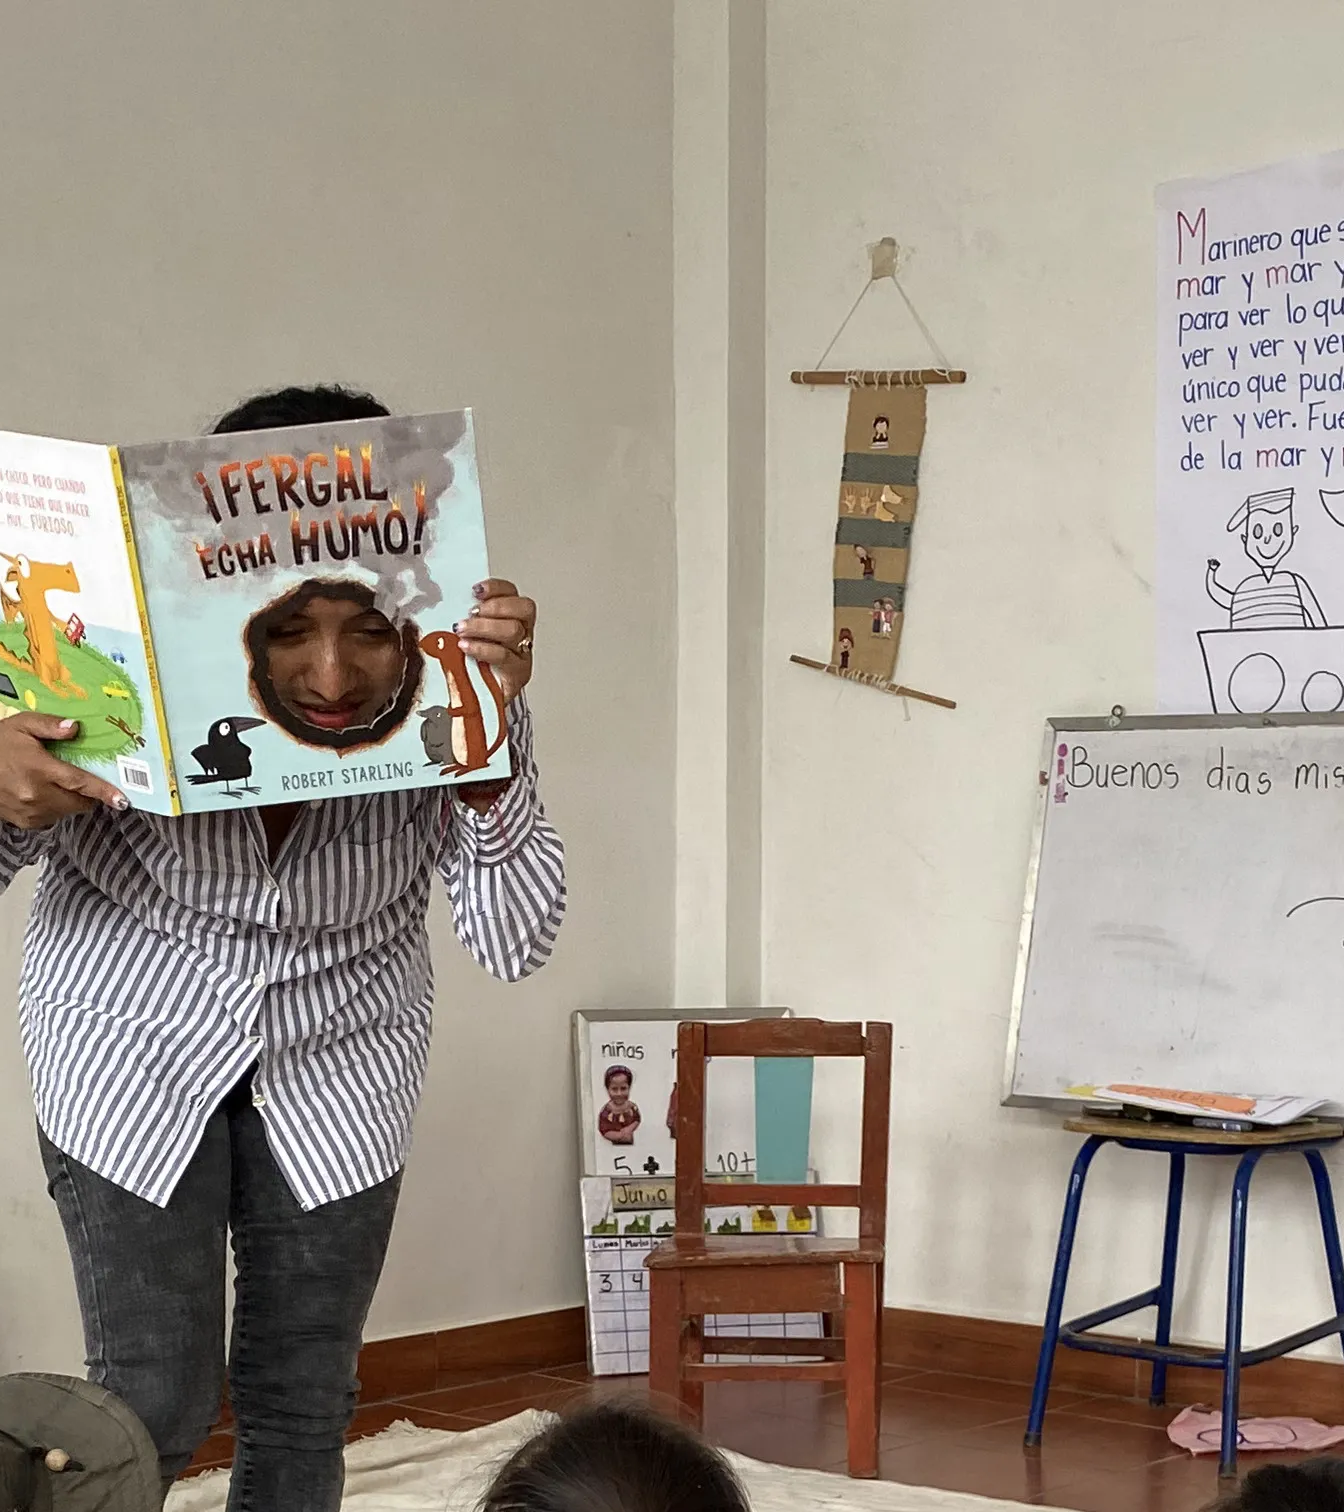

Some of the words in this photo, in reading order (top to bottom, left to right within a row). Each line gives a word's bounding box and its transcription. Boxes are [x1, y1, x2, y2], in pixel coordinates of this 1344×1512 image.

[1177, 207, 1283, 266] Marinero
[1291, 224, 1331, 259] que
[1177, 273, 1226, 300] mar
[1241, 271, 1254, 304] y
[1266, 262, 1322, 288] mar
[1179, 308, 1229, 347] para
[1238, 307, 1270, 327] ver
[1287, 293, 1307, 324] lo
[1182, 347, 1214, 370] ver
[1228, 345, 1239, 370] y
[1249, 337, 1284, 359] ver
[1294, 339, 1306, 365] y
[1182, 379, 1240, 403] único
[1247, 372, 1287, 403] que
[1181, 412, 1218, 434] ver
[1233, 412, 1246, 439] y
[1252, 409, 1297, 430] ver.
[1181, 441, 1204, 471] de
[1221, 440, 1242, 470] la
[1256, 446, 1306, 468] mar
[1320, 446, 1334, 477] y
[195, 441, 388, 524] ¡FERGAL
[196, 532, 277, 580] ECHA
[290, 479, 426, 565] HUMO!
[281, 770, 334, 791] ROBERT
[341, 761, 413, 785] STARLING
[601, 1041, 645, 1060] niñas
[599, 1274, 613, 1293] 3
[632, 1271, 643, 1290] 4
